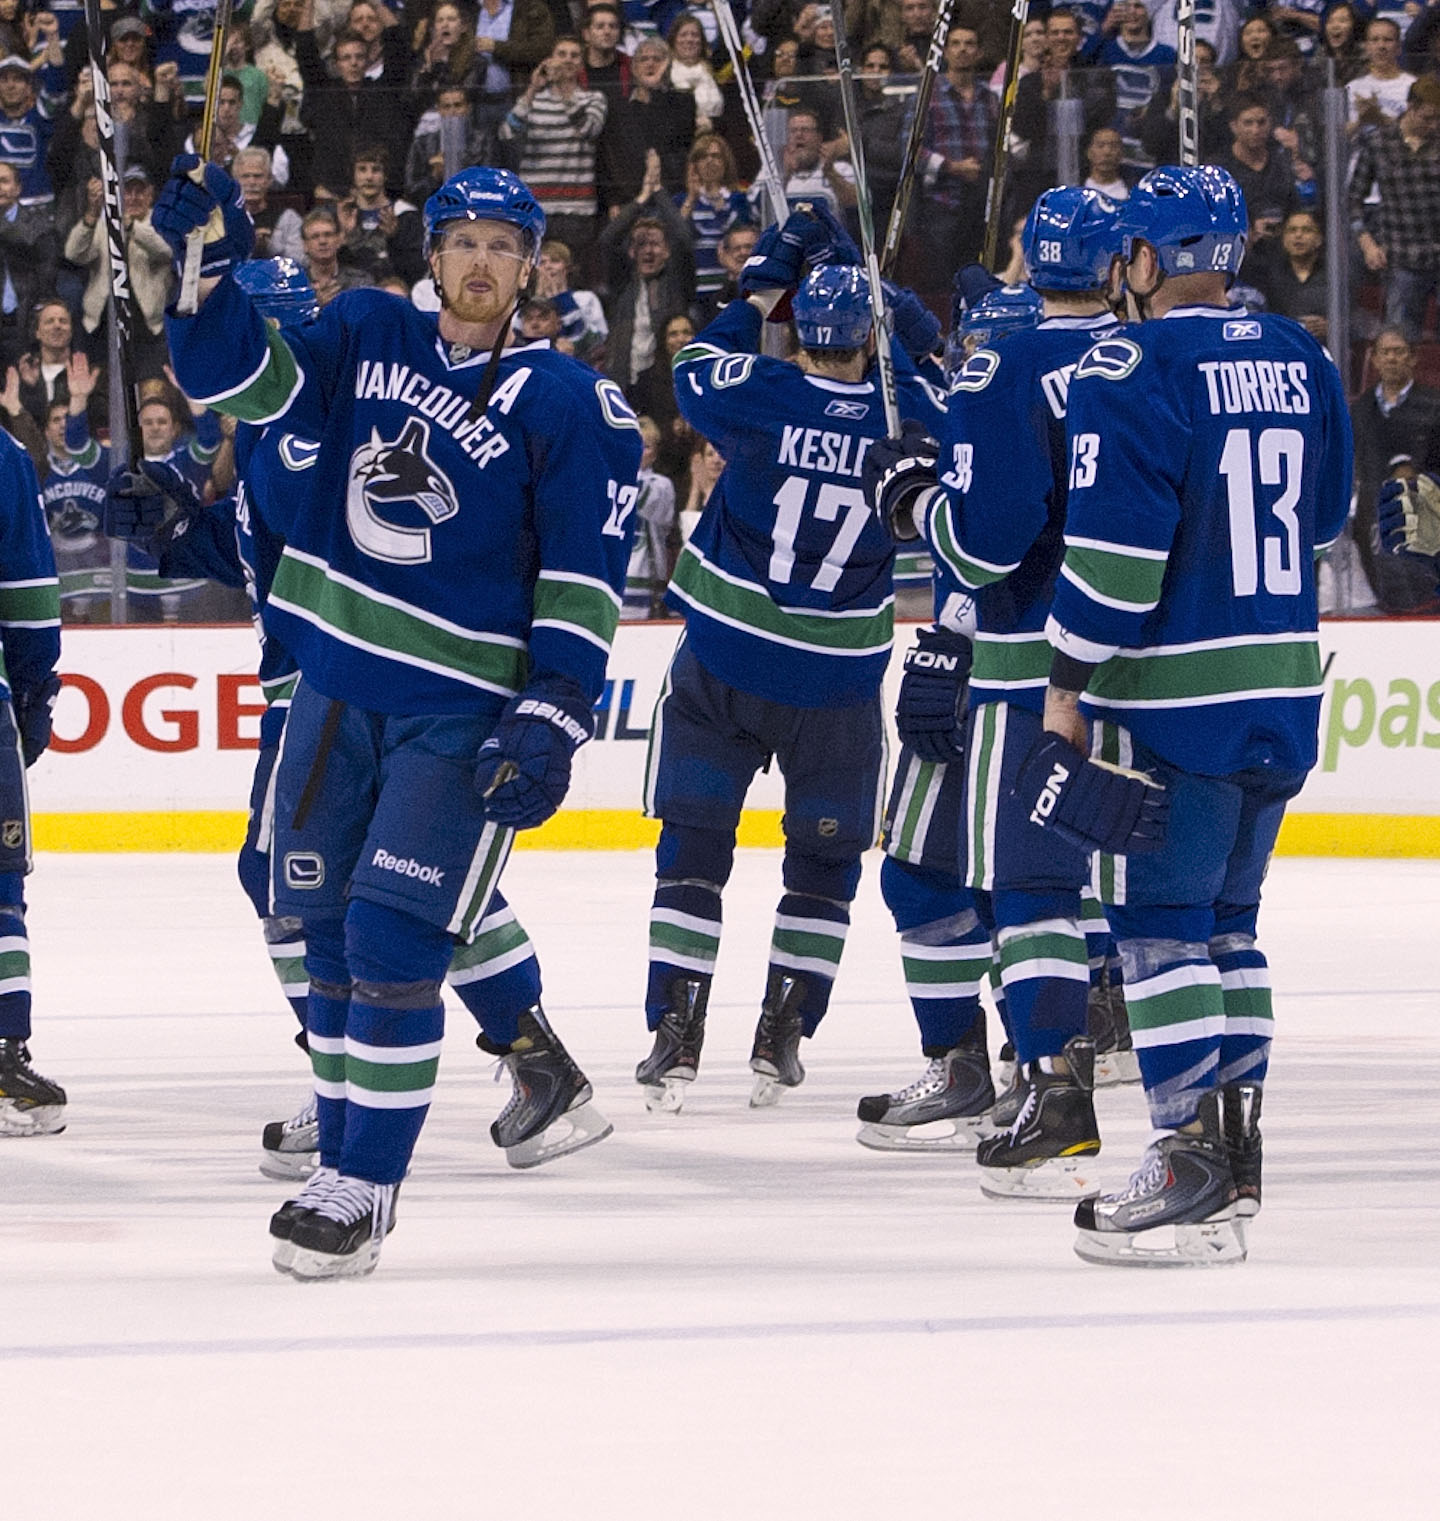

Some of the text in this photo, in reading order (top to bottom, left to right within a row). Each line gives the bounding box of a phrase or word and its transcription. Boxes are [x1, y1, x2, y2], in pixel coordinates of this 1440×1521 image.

[1039, 239, 1061, 262] 38
[1211, 243, 1230, 265] 13
[816, 326, 833, 346] 17
[487, 366, 533, 416] A
[1198, 361, 1312, 416] TORRES
[768, 475, 873, 593] 17
[1218, 428, 1306, 598] 13
[1029, 761, 1072, 827] TON
[372, 848, 445, 887] Reebok
